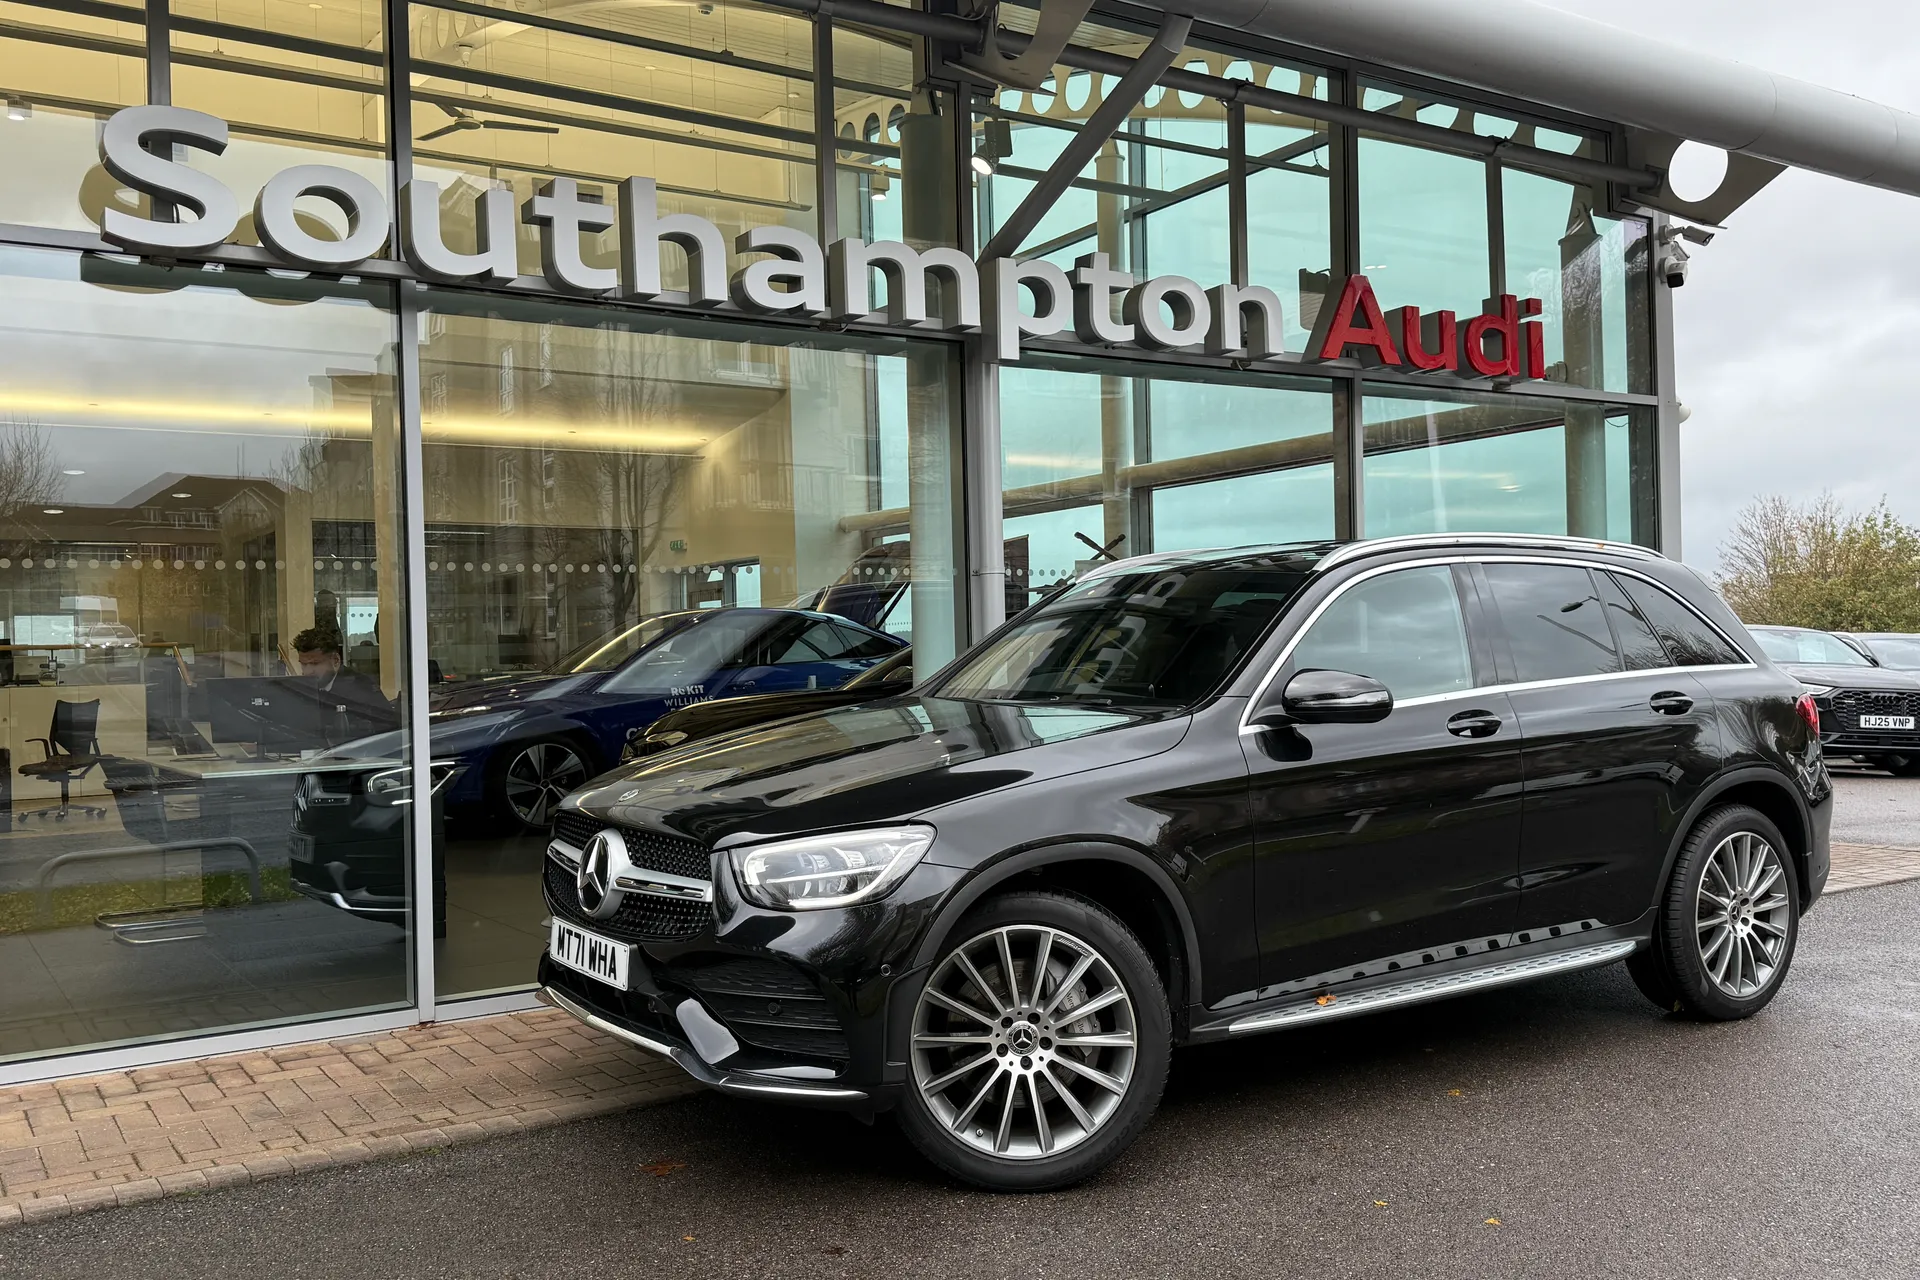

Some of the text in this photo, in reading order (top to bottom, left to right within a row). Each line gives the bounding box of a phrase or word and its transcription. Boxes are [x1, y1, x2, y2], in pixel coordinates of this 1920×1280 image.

[100, 104, 1545, 379] Southampton Audi
[664, 695, 714, 707] WILLIAMS
[1864, 716, 1911, 727] HJ25 VNP
[557, 924, 617, 981] MT71 WHA
